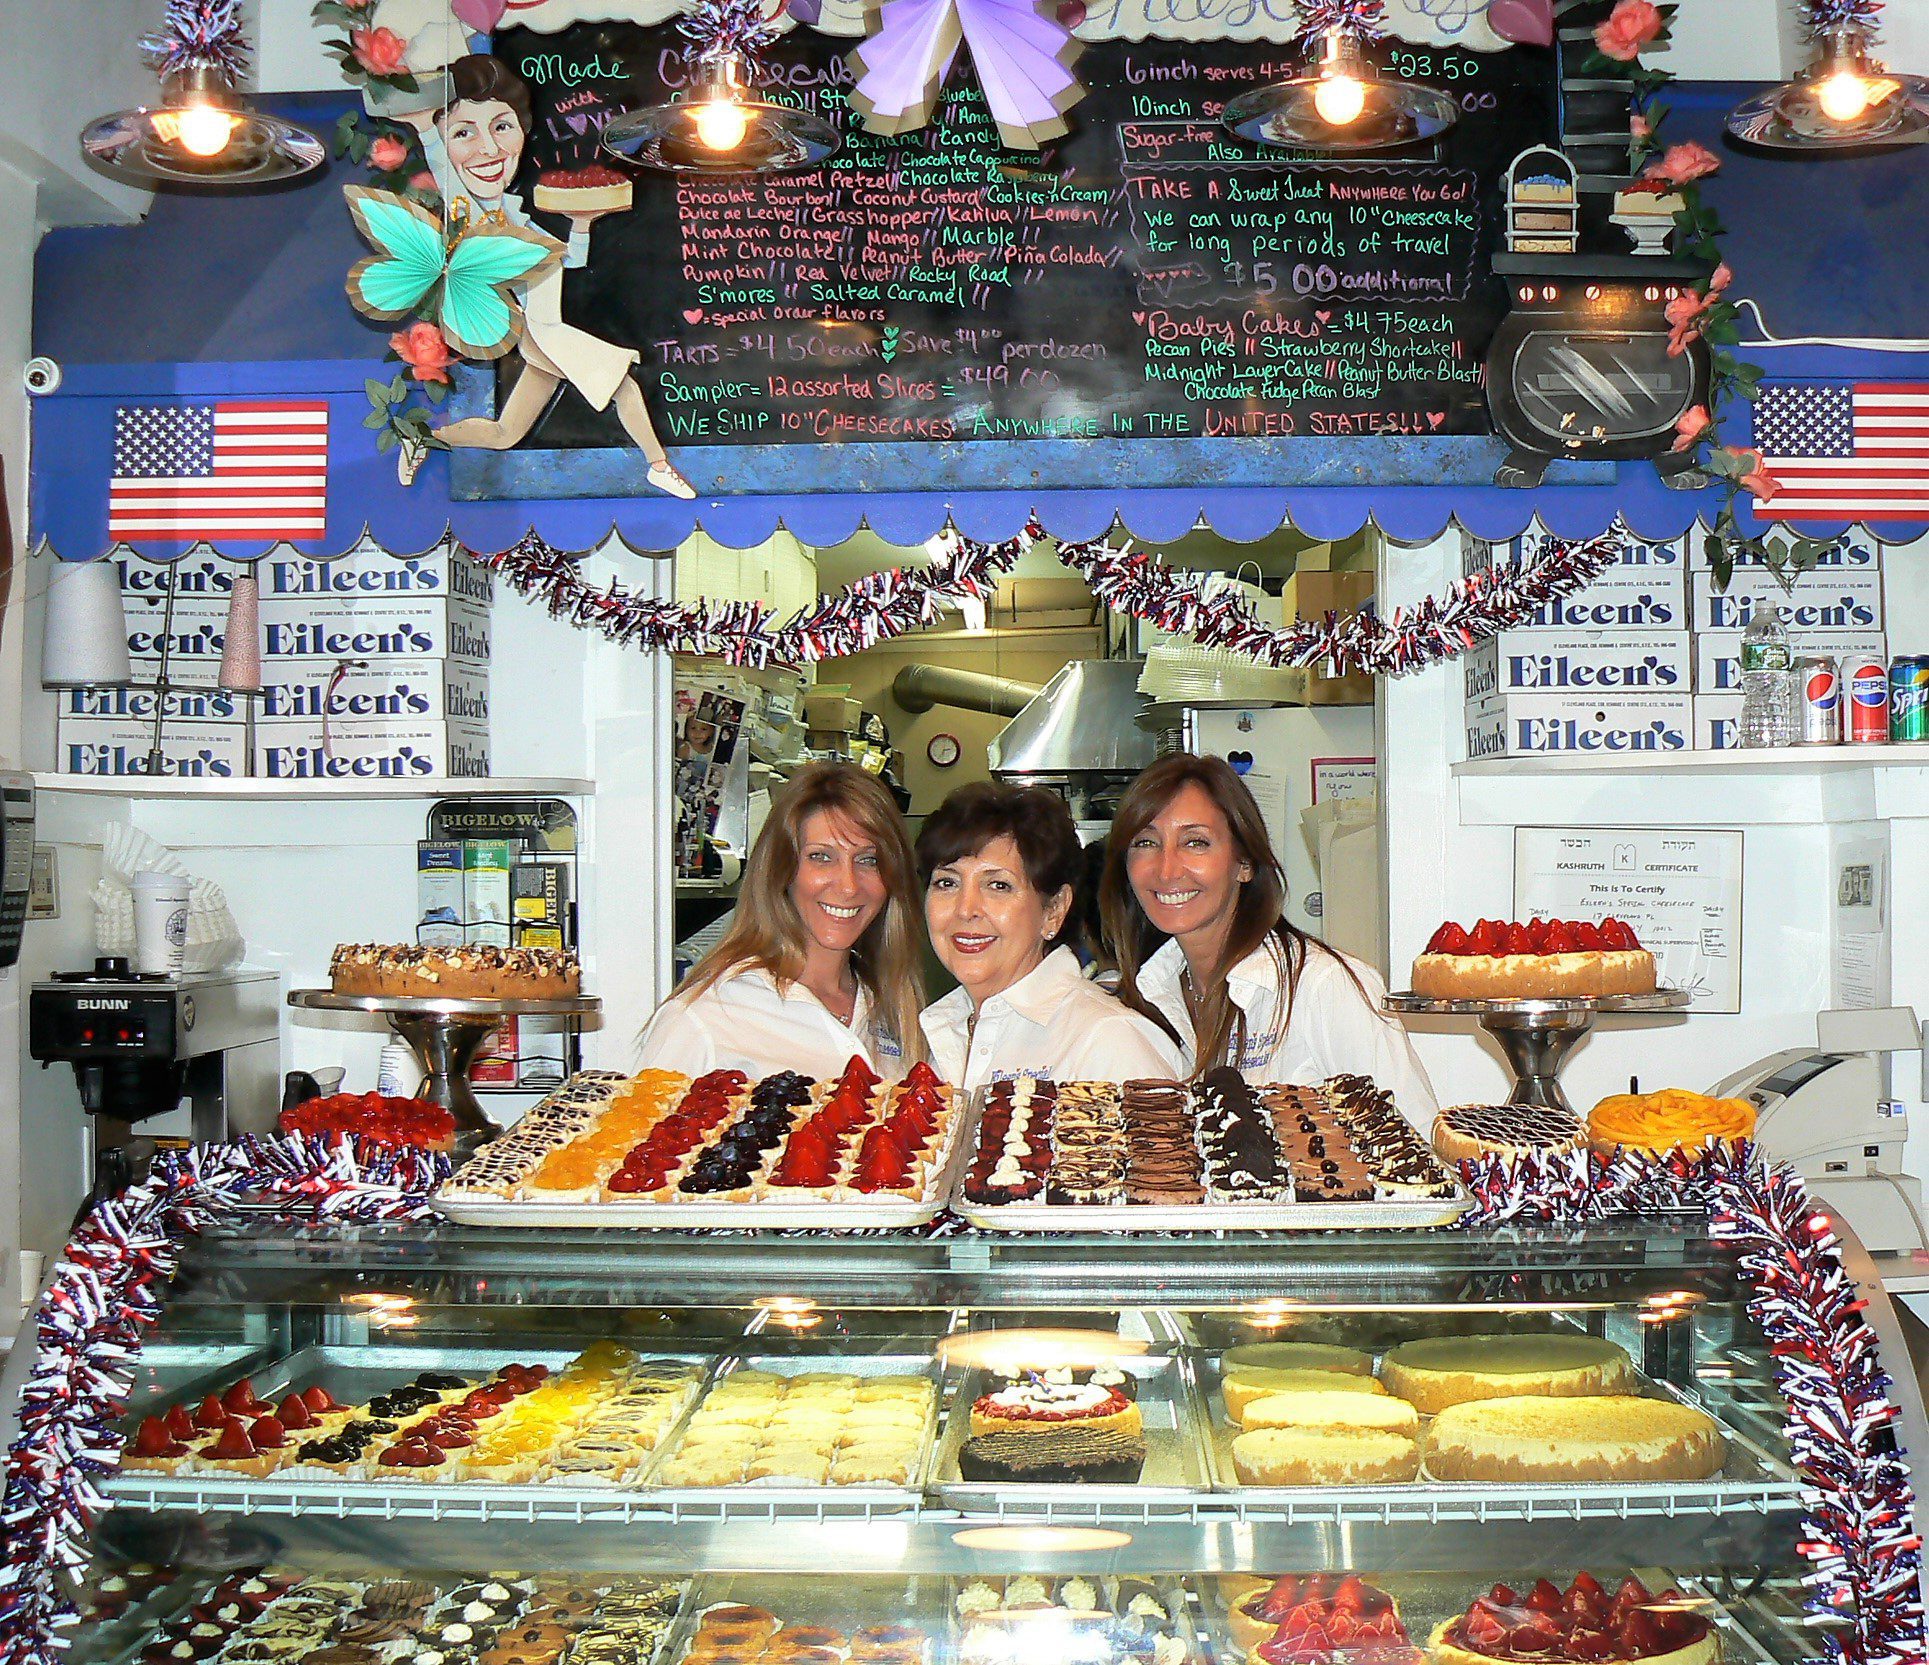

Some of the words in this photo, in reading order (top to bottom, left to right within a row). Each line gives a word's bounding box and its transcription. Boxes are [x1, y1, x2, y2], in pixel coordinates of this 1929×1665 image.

[521, 54, 630, 87] Made
[1203, 63, 1254, 81] serves
[555, 91, 603, 113] with
[846, 132, 922, 148] Banana
[940, 128, 1000, 151] Candy
[1208, 144, 1243, 160] Also
[900, 151, 966, 167] Chocolate
[764, 170, 824, 188] Caramel
[830, 171, 893, 192] Pretzel
[899, 170, 980, 186] Chocolate
[1128, 176, 1192, 199] TAKE
[1208, 180, 1219, 199] A
[1227, 177, 1279, 202] Sweet
[1284, 174, 1323, 200] Treat
[1329, 182, 1407, 200] ANYWHERE
[677, 189, 757, 205] Chocolate
[764, 189, 830, 206] Bourbon
[853, 189, 917, 206] Coconut
[921, 188, 980, 208] Custard
[1060, 185, 1108, 205] Cream
[678, 207, 719, 221] Dulce
[724, 207, 741, 220] de
[747, 207, 794, 222] Leche
[812, 207, 932, 230] Grasshopper
[947, 206, 1013, 224] Kahlua
[1030, 205, 1099, 225] Lemon
[1144, 209, 1174, 228] We
[1189, 212, 1222, 228] can
[1231, 212, 1286, 233] wrap
[1294, 209, 1333, 238] any
[681, 225, 770, 240] Mandarin
[779, 224, 842, 246] Orange
[867, 230, 920, 252] Mango
[942, 227, 1015, 246] Marble
[1146, 230, 1178, 252] for
[1189, 232, 1231, 263] long
[1253, 235, 1346, 258] periods
[1358, 231, 1381, 253] of
[1391, 232, 1450, 255] travel
[681, 243, 728, 260] Mint
[737, 242, 836, 261] Chocolate
[862, 246, 922, 265] Peanut
[932, 247, 987, 267] Butter
[1004, 245, 1047, 264] Piña
[1050, 245, 1107, 267] Colada
[682, 264, 765, 285] Pumpkin
[795, 266, 829, 281] Red
[840, 262, 891, 282] Velvet
[909, 265, 956, 290] Rocky
[968, 264, 1012, 287] Road
[1341, 269, 1452, 295] additional
[698, 285, 776, 304] S'mores
[810, 284, 880, 301] Salted
[887, 284, 965, 308] Caramel
[822, 304, 886, 321] flavors
[1149, 310, 1235, 344] Baby
[1242, 310, 1319, 338] Cakes
[653, 339, 719, 365] TARTS
[1145, 338, 1190, 357] Pecan
[1200, 338, 1236, 358] Pies
[1260, 336, 1366, 365] Strawberry
[1370, 336, 1450, 359] Shortcake
[1145, 360, 1225, 384] Midnight
[1338, 360, 1383, 383] Peanut
[1387, 360, 1434, 382] Butter
[1437, 360, 1480, 384] Blast
[768, 376, 788, 398] 12
[792, 373, 873, 400] assorted
[876, 373, 936, 401] Slices
[1184, 381, 1257, 401] Chocolate
[1260, 380, 1301, 408] Fudge
[1343, 380, 1381, 399] Blast
[667, 409, 710, 438] WE
[717, 408, 769, 436] SHIP
[814, 408, 954, 439] CHEESECAKES
[973, 407, 1098, 437] ANYWHERE
[1113, 412, 1133, 433] IN
[1143, 413, 1190, 433] THE
[1206, 408, 1294, 436] UNITED
[118, 560, 233, 593] leen's
[270, 560, 440, 594] Eileen's
[452, 560, 493, 603] Eileen's
[1707, 595, 1874, 628] Eieen's
[264, 623, 433, 656] Eileen's
[450, 622, 490, 659] Eileen's
[1507, 654, 1678, 688] Eileen's
[262, 684, 430, 717] Eileen's
[447, 683, 488, 719] Eileen's
[1467, 721, 1505, 759] Eileen's
[1515, 717, 1685, 752] Eileen's
[264, 746, 434, 778] Eileen's
[450, 744, 490, 778] Eileen's
[441, 814, 538, 826] BIGELOW
[1556, 862, 1605, 871] KASHRUTH
[1644, 864, 1699, 873] CERTIFICATE
[1621, 854, 1628, 863] K
[1589, 884, 1609, 893] This
[1621, 885, 1633, 893] To
[1635, 885, 1666, 896] Certify
[77, 999, 129, 1010] BUNN
